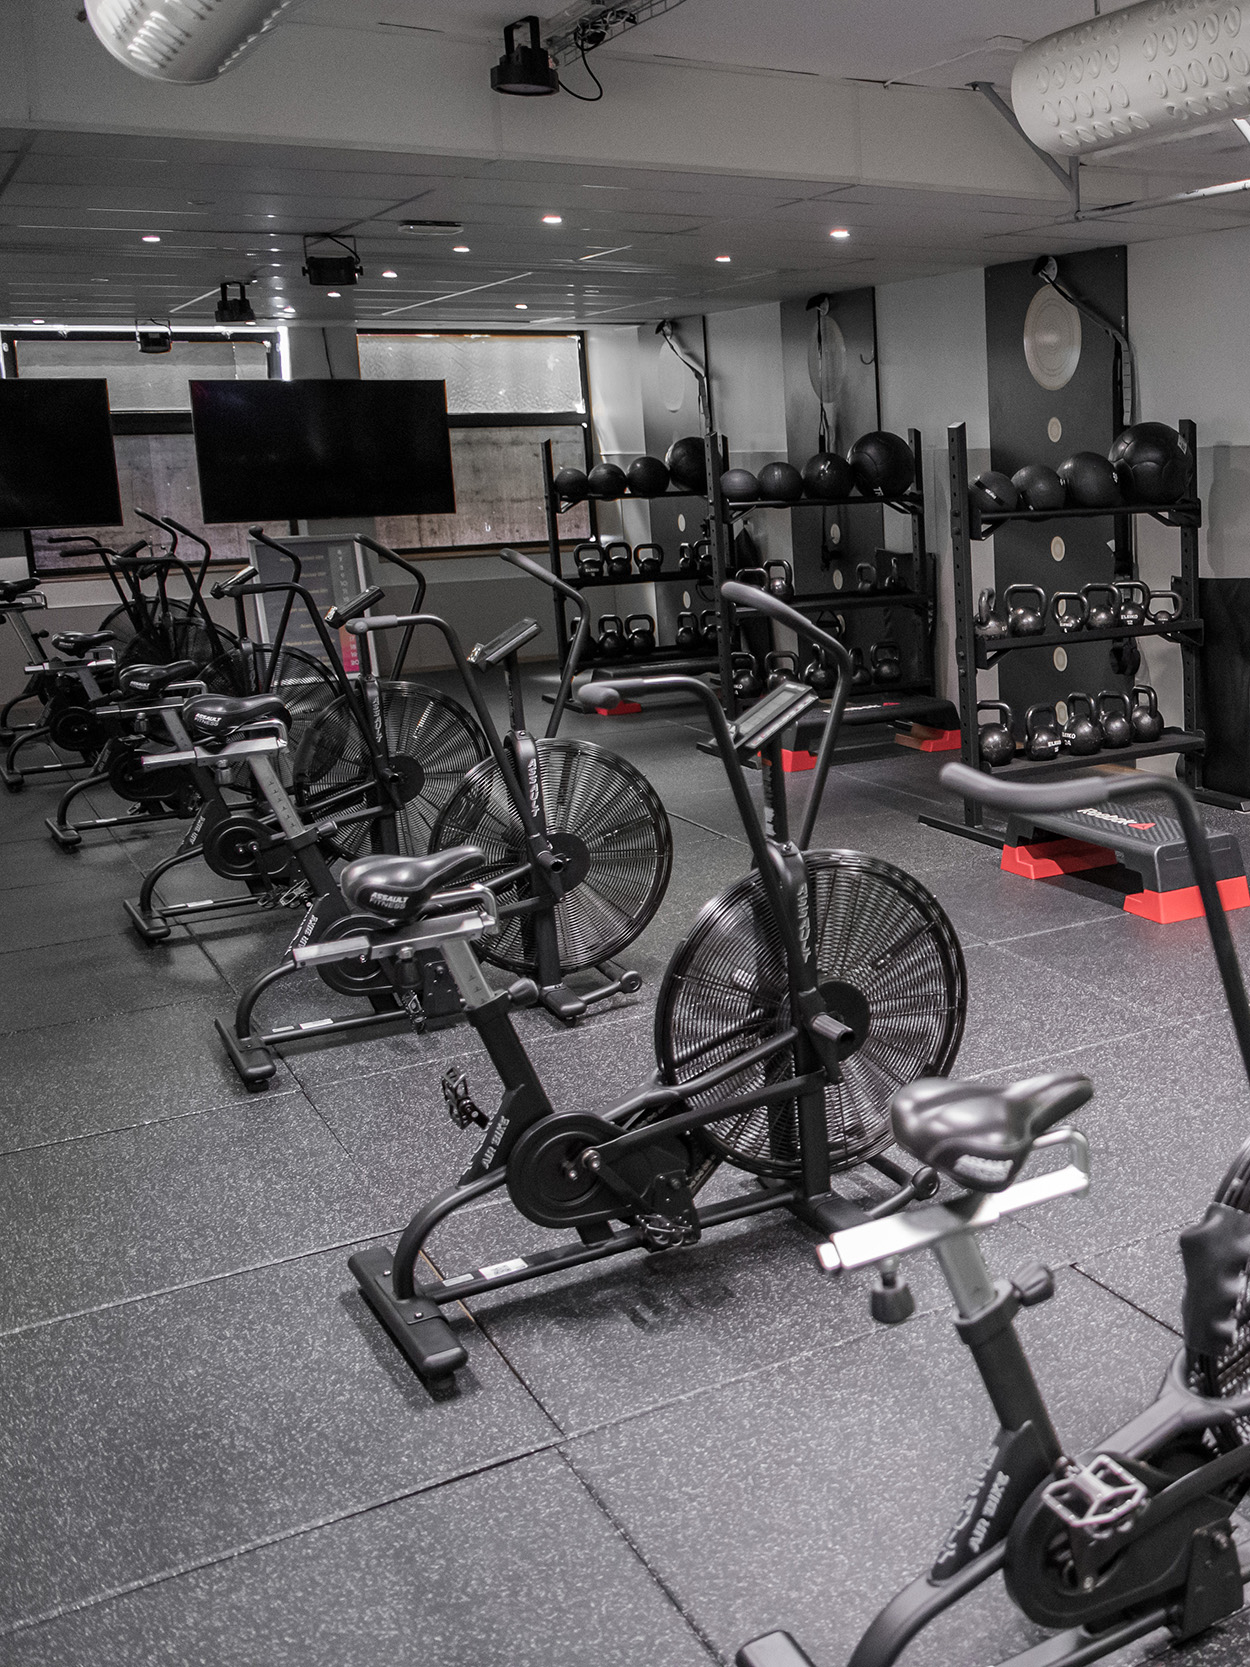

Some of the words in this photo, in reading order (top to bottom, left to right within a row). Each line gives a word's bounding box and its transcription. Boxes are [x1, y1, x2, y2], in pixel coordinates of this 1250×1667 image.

[527, 757, 541, 818] ASSAULT
[369, 897, 406, 910] FITNESS
[370, 891, 410, 903] ASSAULT
[797, 882, 812, 964] ASSAULT
[481, 1146, 497, 1170] AIR
[490, 1115, 510, 1147] BIKE
[969, 1518, 991, 1553] AIR
[982, 1470, 1010, 1517] BIKE
